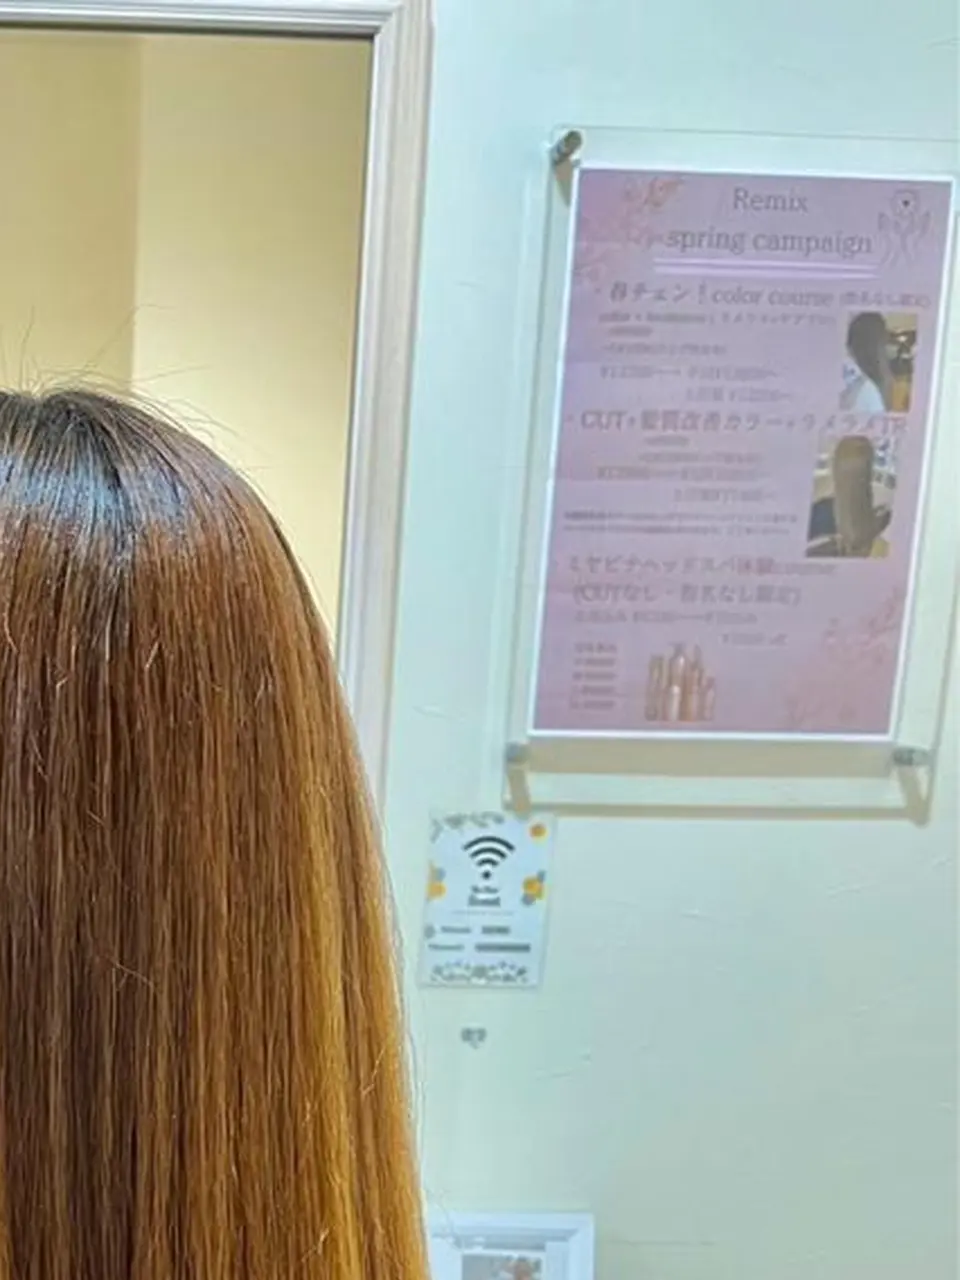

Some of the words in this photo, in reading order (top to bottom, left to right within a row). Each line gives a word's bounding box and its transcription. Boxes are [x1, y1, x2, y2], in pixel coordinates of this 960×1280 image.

[732, 187, 809, 213] Remix
[665, 229, 746, 255] spring
[752, 231, 874, 260] campaign
